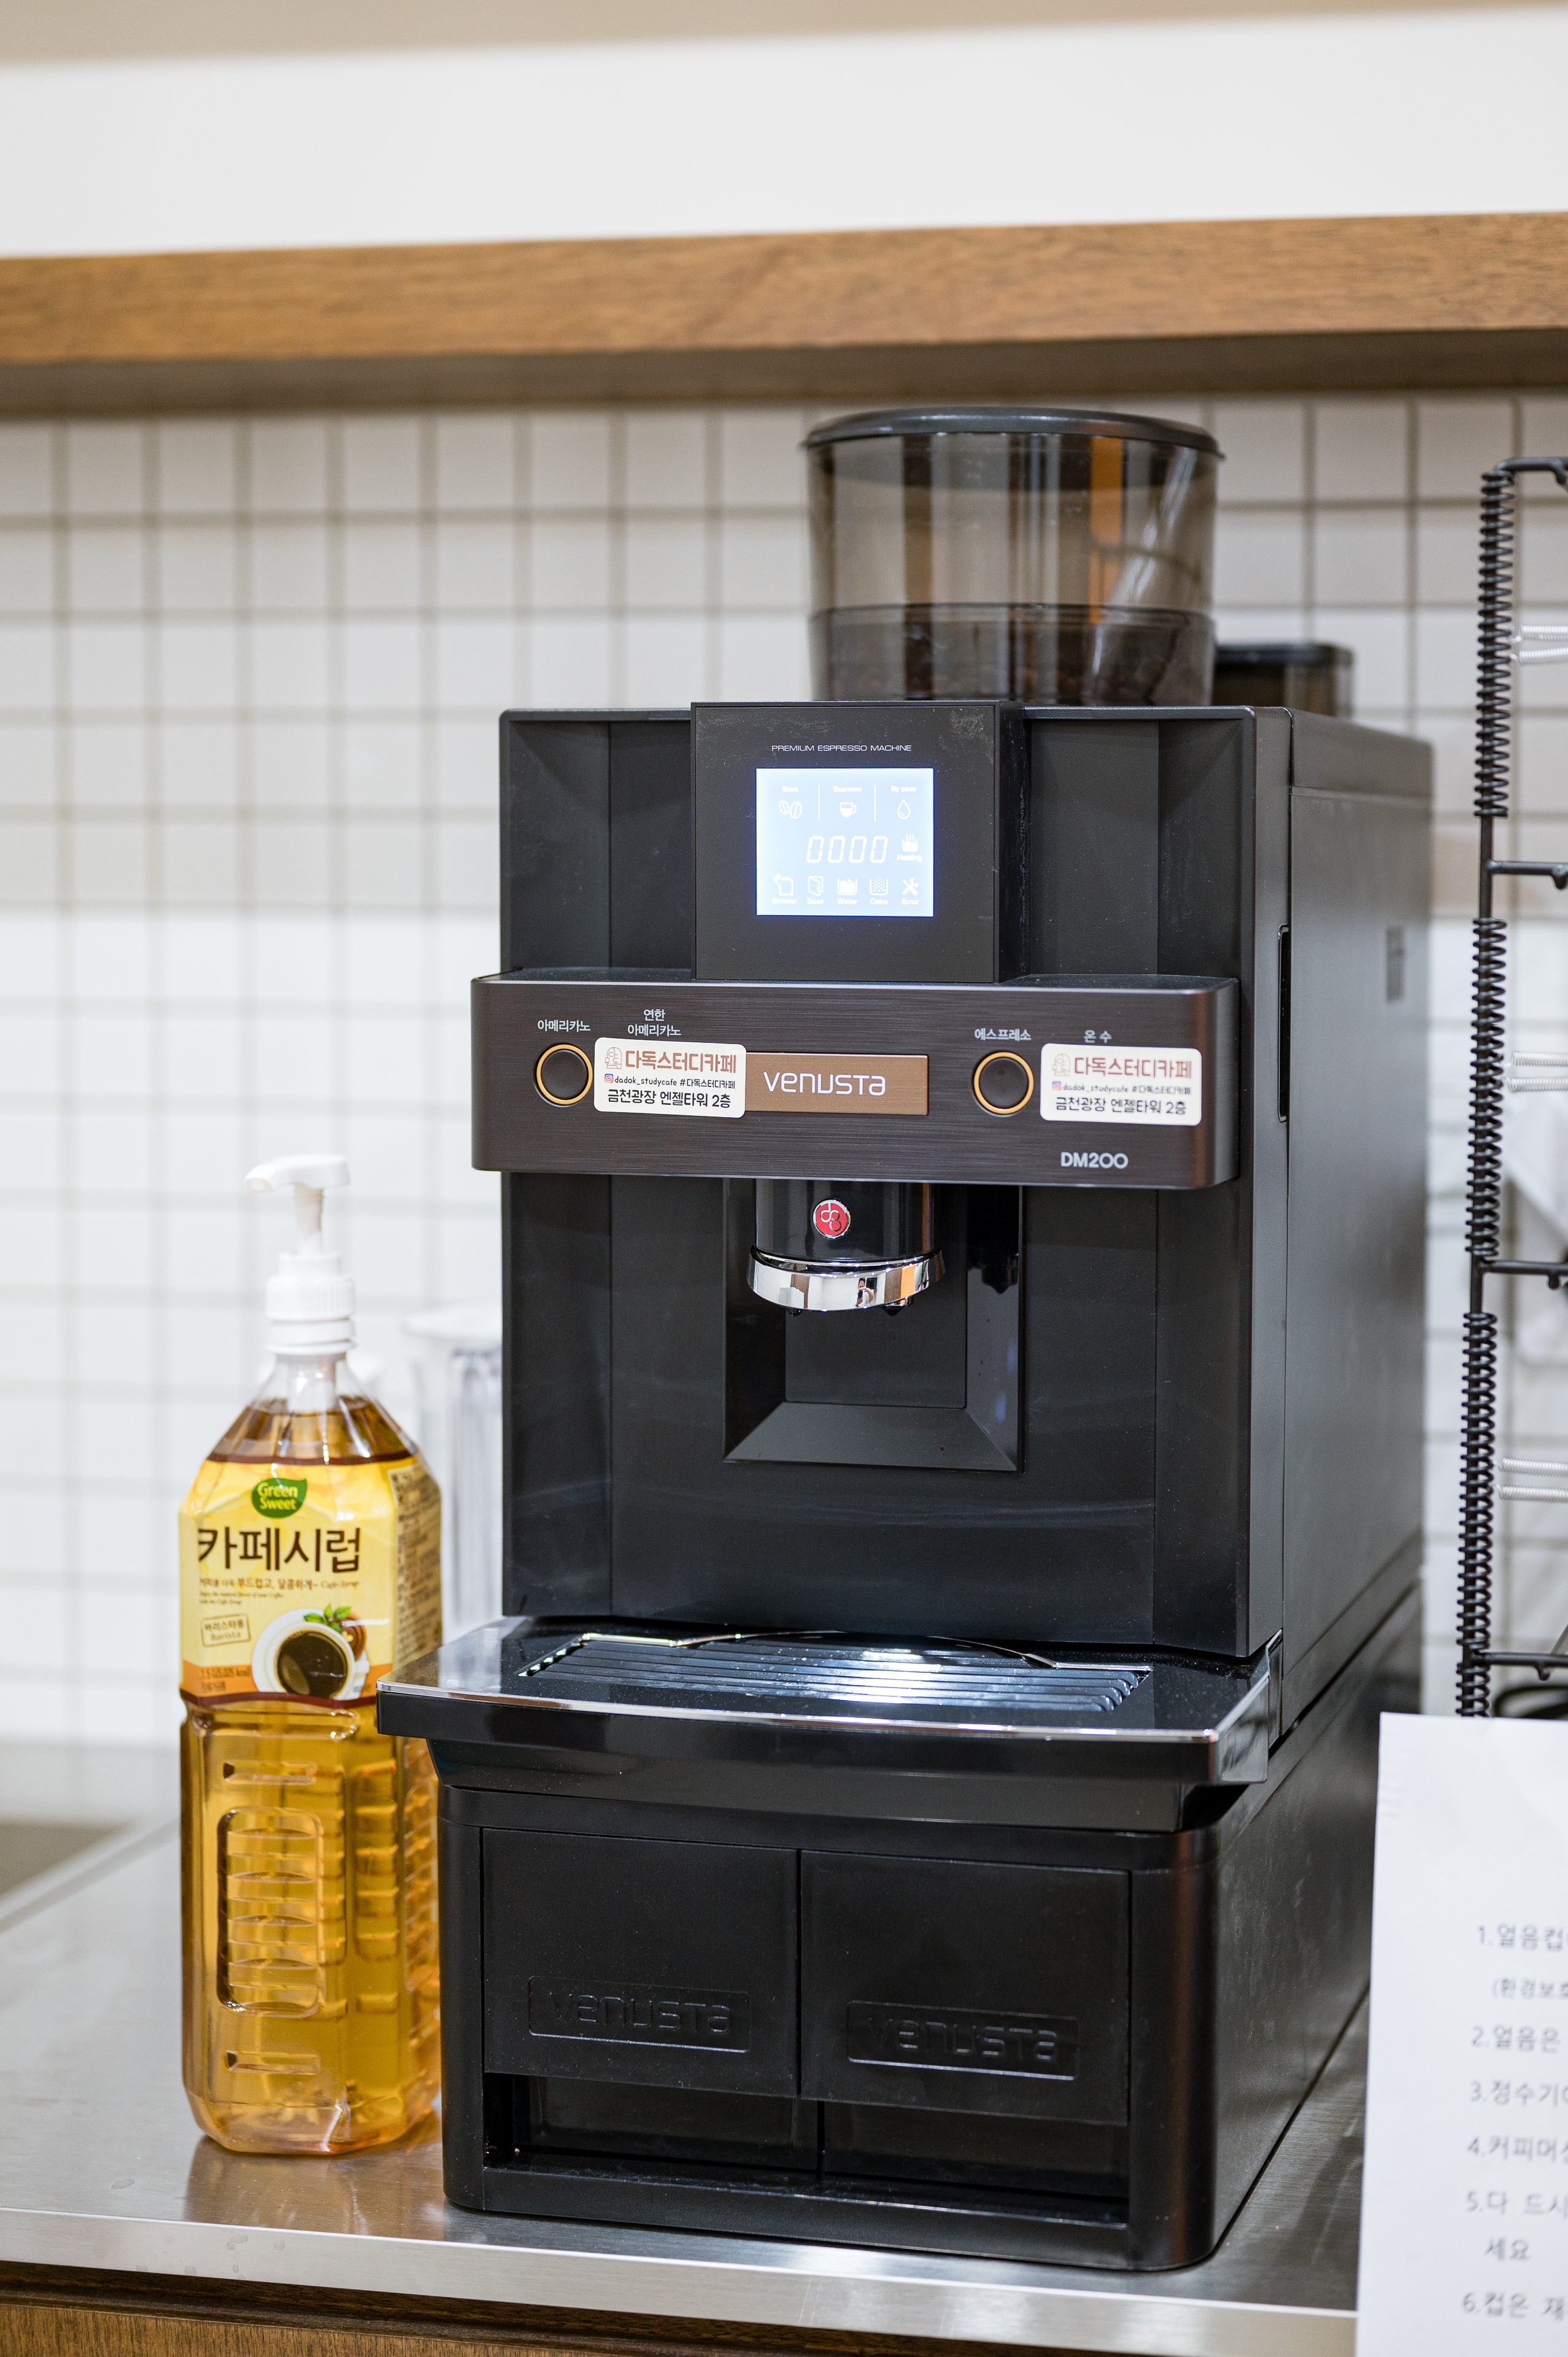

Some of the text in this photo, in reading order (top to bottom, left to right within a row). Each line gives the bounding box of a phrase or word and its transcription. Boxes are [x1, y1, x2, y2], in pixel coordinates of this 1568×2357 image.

[806, 835, 889, 864] 0000
[897, 854, 923, 862] Heating
[643, 1008, 666, 1021] 연한
[537, 1019, 591, 1032] 아메리카노
[627, 1023, 682, 1037] 아메리카노
[974, 1028, 1032, 1042] 에스프레소
[625, 1050, 736, 1074] 다독스터디카페
[1074, 1056, 1192, 1079] 다독스터디카페
[614, 1075, 678, 1087] dadok_studycafe
[608, 1088, 731, 1109] 금천광장 엔젤타워 2층
[1056, 1096, 1186, 1115] 금천광장 엔젤타워 2층
[1060, 1151, 1129, 1170] DM200
[258, 1482, 299, 1498] Green
[260, 1496, 297, 1510] Sweet
[198, 1526, 361, 1574] 카페시럽
[1477, 1923, 1567, 1952] 1.얼음컵
[1485, 2237, 1531, 2262] 세요
